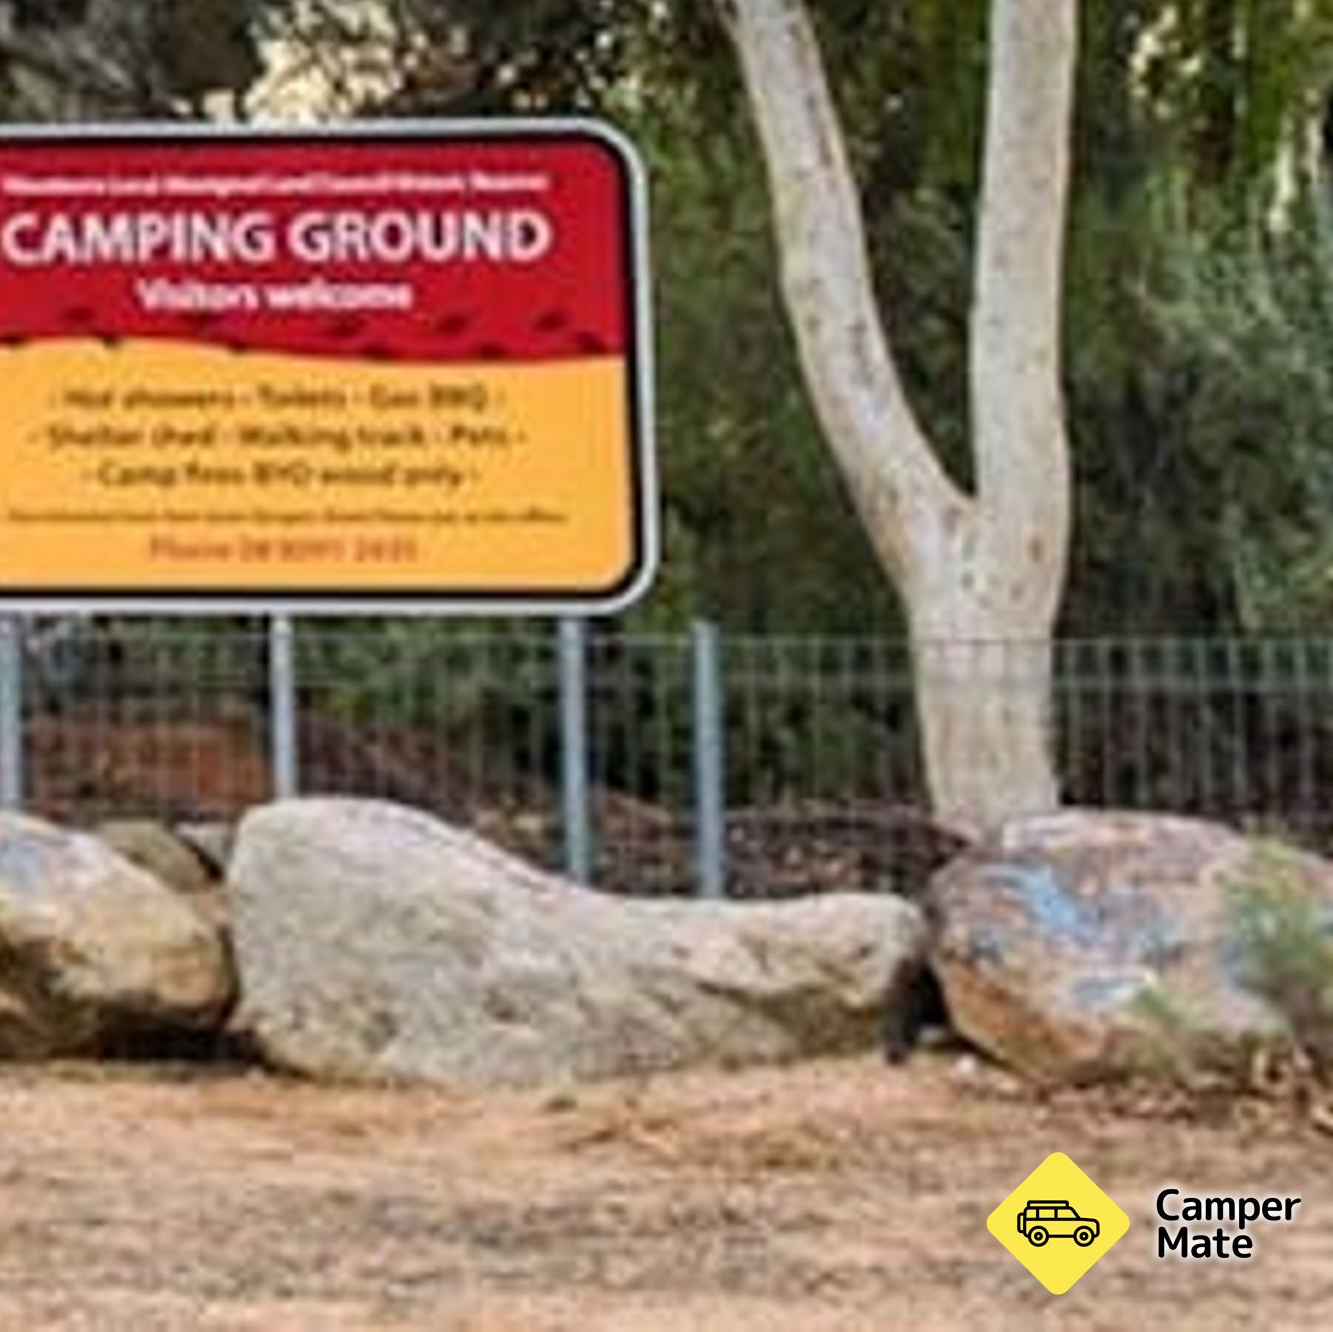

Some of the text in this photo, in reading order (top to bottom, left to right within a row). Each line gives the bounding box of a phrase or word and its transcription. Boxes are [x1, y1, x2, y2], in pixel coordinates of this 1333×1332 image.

[0, 210, 551, 264] CAMPING GROUND
[136, 278, 412, 310] Visitors welcome
[122, 388, 236, 410] showers
[46, 424, 144, 449] Shelter
[237, 425, 352, 454] Walking
[356, 425, 426, 447] track
[96, 461, 178, 489] Camp
